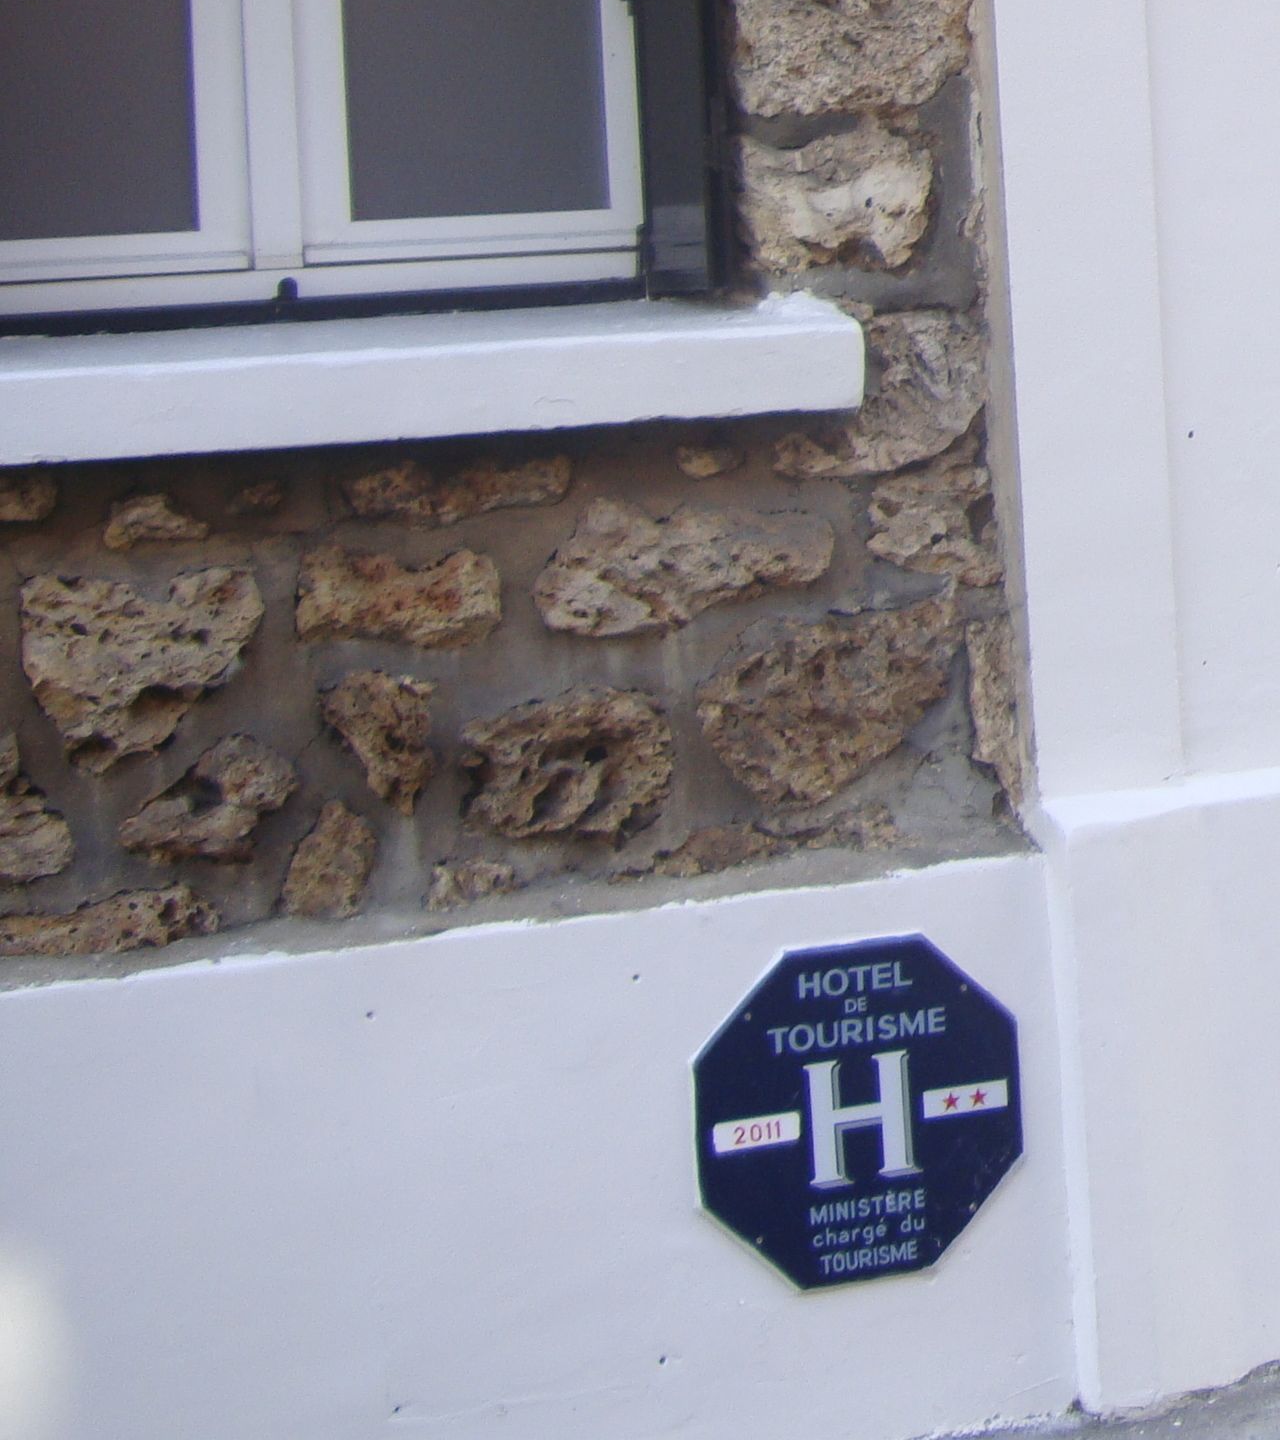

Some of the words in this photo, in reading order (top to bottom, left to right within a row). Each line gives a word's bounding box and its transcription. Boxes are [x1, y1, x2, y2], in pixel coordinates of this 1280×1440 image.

[798, 960, 914, 999] HOTEL
[844, 996, 868, 1014] DE
[767, 1006, 947, 1054] TOURISME
[733, 1119, 783, 1147] 2011
[803, 1048, 923, 1190] H
[809, 1188, 927, 1226] MINISTÈRE
[812, 1216, 888, 1248] chargé
[900, 1213, 926, 1233] du
[819, 1239, 919, 1275] TOURISME
